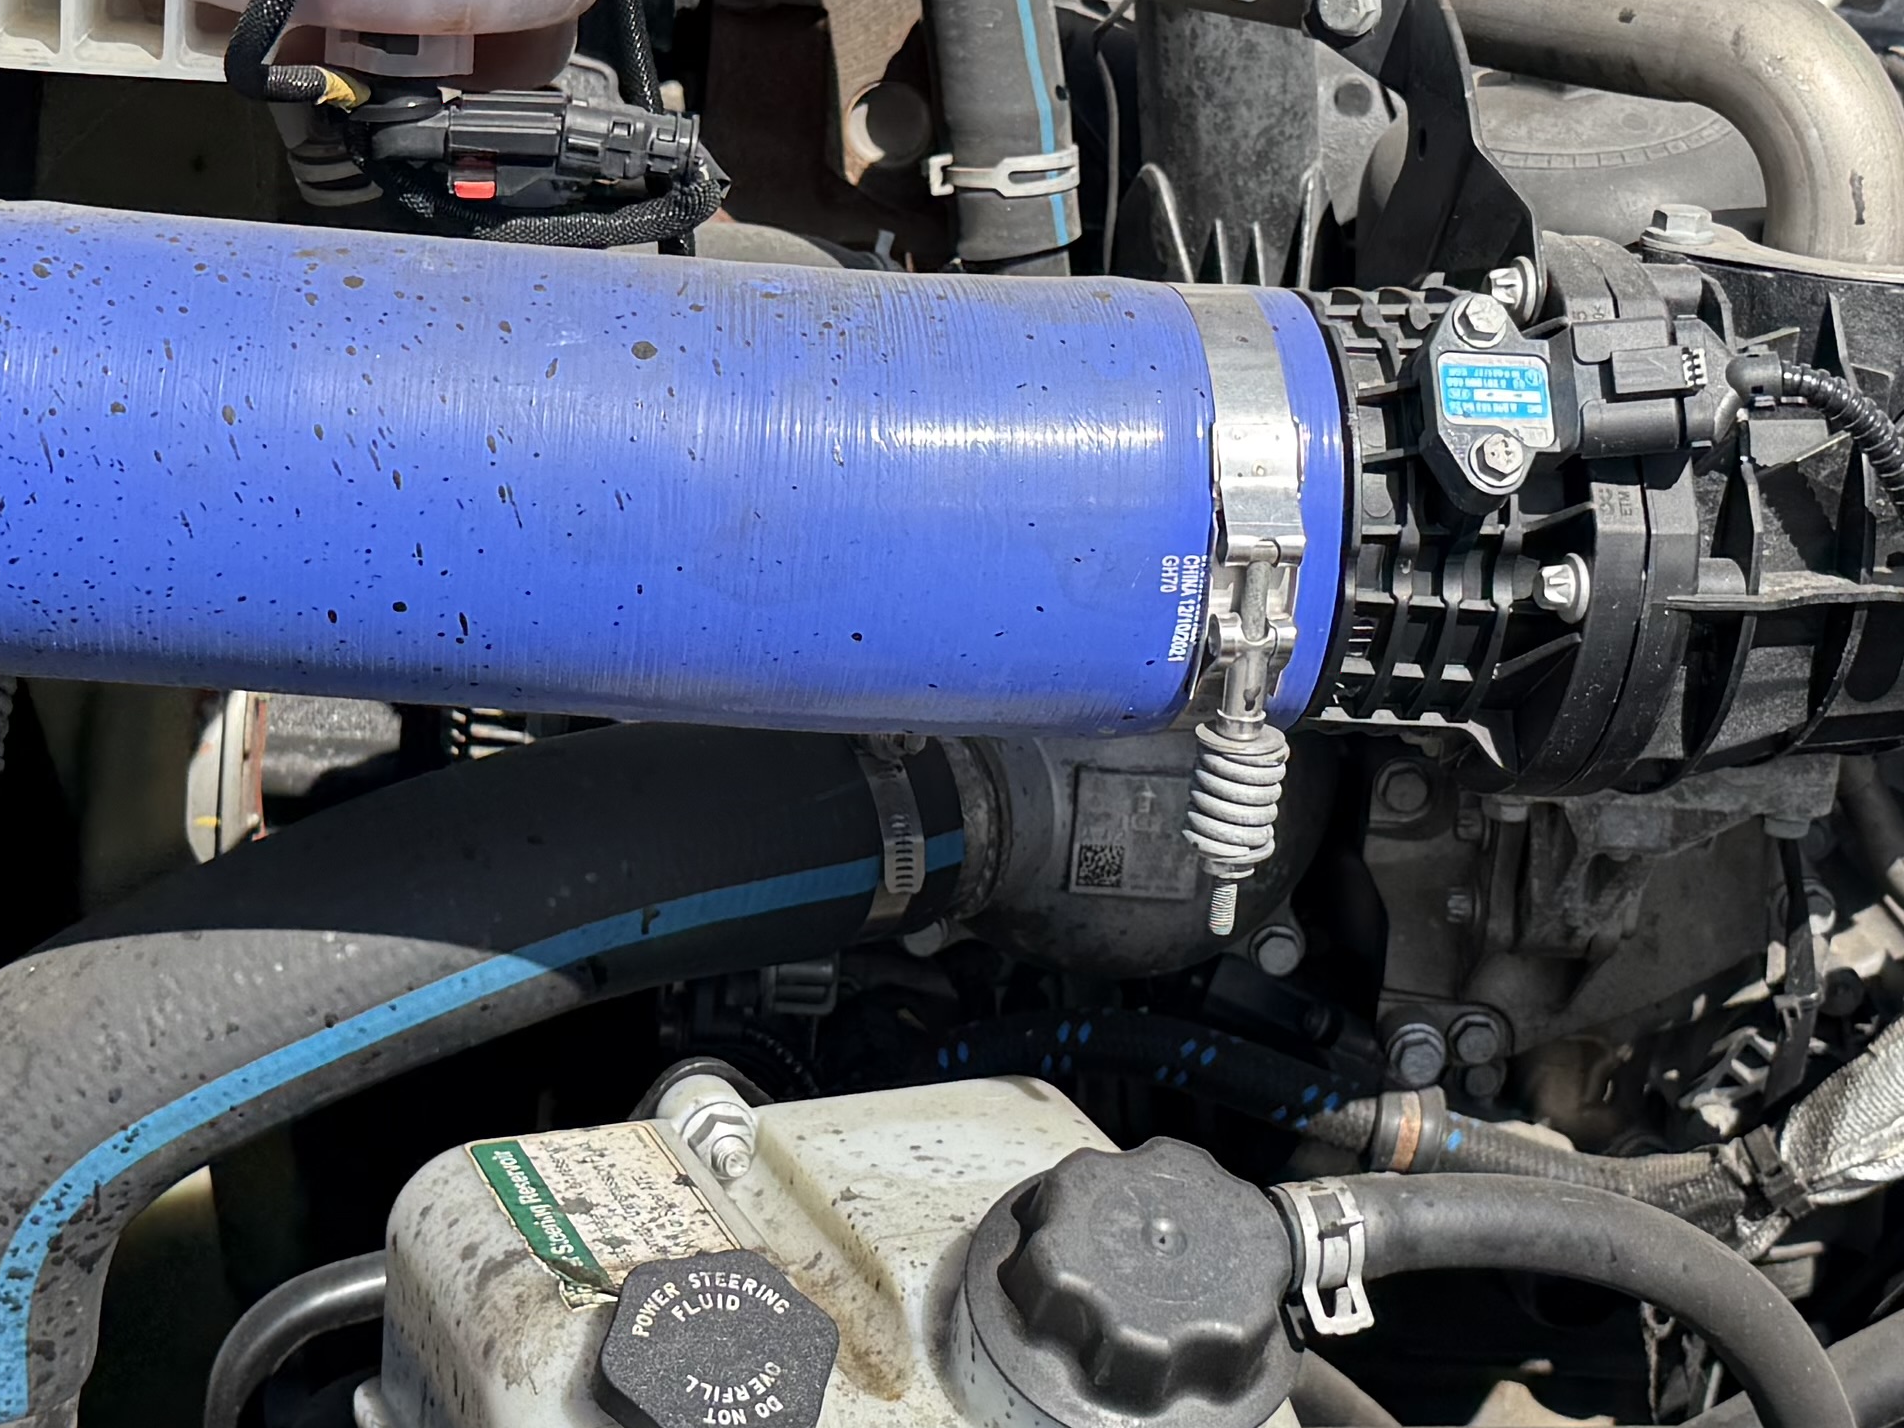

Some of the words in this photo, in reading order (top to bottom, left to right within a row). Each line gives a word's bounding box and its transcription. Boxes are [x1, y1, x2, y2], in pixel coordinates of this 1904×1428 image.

[1160, 555, 1180, 593] GH70
[1180, 555, 1200, 597] CHINA
[1167, 599, 1196, 662] 12/10/2021
[491, 1150, 536, 1206] Reservoir
[632, 1282, 680, 1337] POWER
[688, 1272, 790, 1315] STEERING
[671, 1293, 740, 1322] FLUID
[685, 1362, 781, 1404] OVERFILL
[703, 1408, 747, 1425] NOT
[755, 1395, 783, 1418] DO
